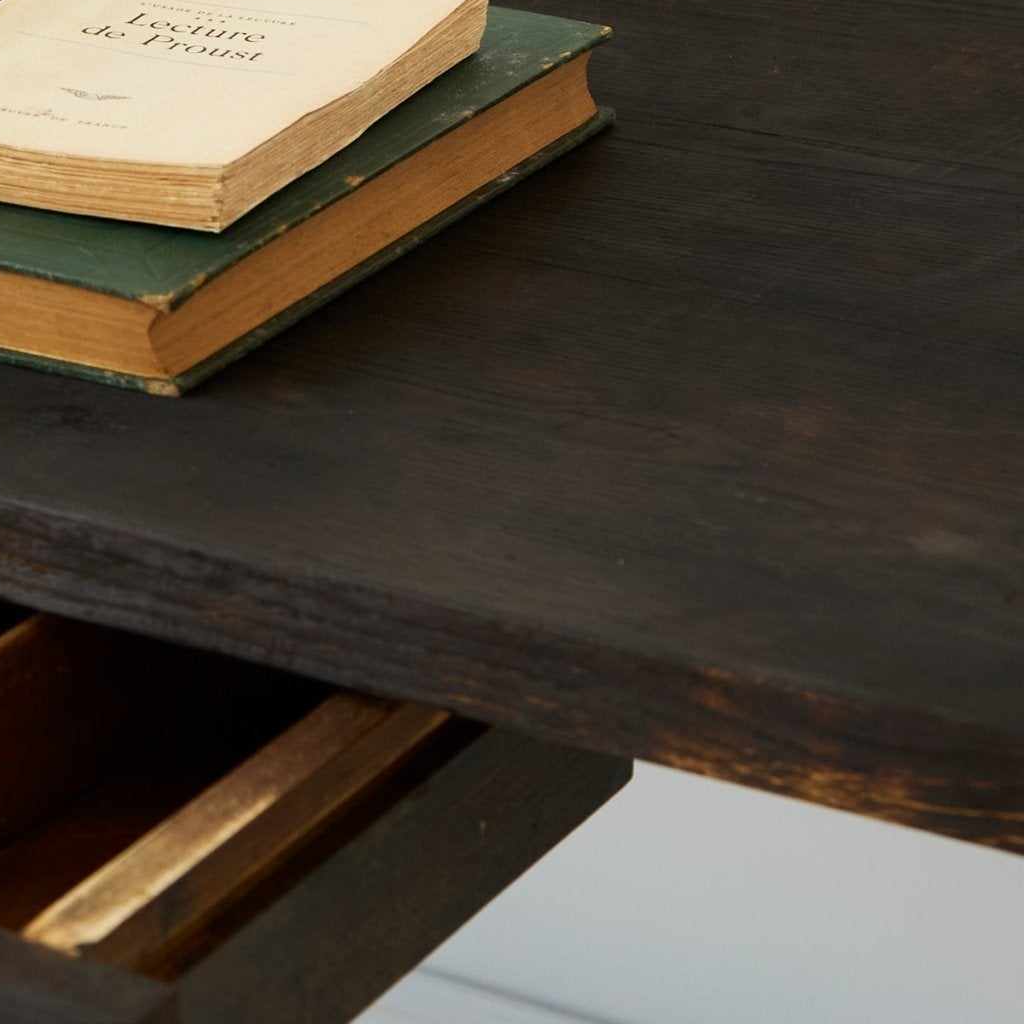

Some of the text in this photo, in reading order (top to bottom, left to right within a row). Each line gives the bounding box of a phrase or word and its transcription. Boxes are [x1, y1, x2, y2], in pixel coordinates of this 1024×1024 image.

[81, 24, 265, 63] de Proust
[125, 12, 267, 44] Lecture
